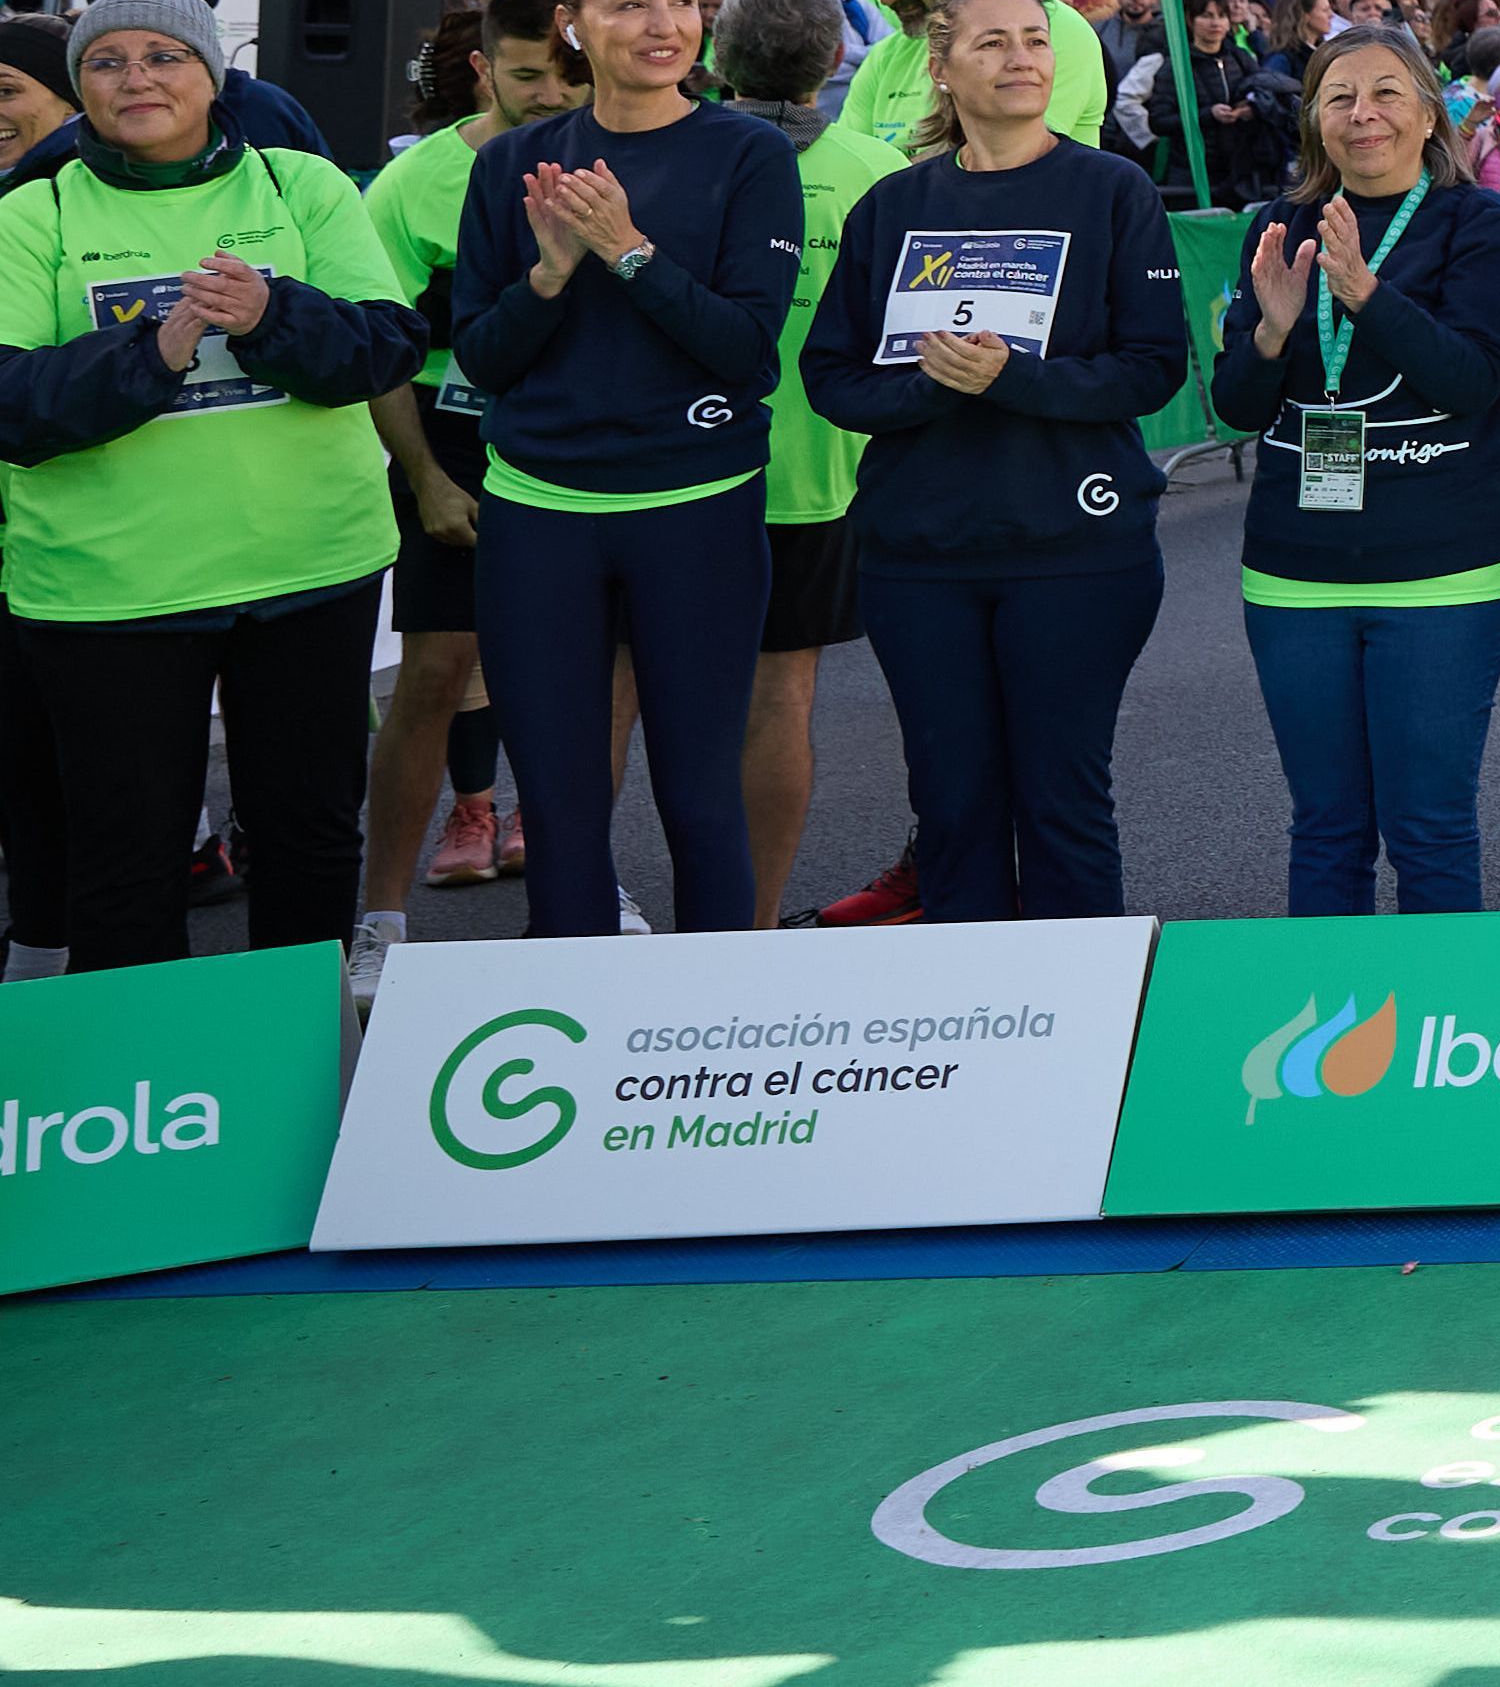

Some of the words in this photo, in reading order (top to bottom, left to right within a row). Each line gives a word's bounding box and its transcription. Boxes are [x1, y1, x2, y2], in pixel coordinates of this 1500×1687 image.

[102, 249, 151, 262] Iberdrola
[908, 250, 955, 289] XII
[956, 262, 988, 270] Madrid
[1001, 262, 1037, 271] marcha
[953, 270, 990, 279] contra
[992, 270, 1006, 279] el
[1008, 269, 1050, 282] cáncer
[952, 300, 975, 326] 5
[624, 1011, 852, 1056] asociación
[861, 1003, 1057, 1055] española
[614, 1066, 755, 1103] contra
[765, 1060, 805, 1099] el
[811, 1054, 959, 1095] cáncer
[602, 1120, 656, 1154] en
[665, 1110, 819, 1152] Madrid
